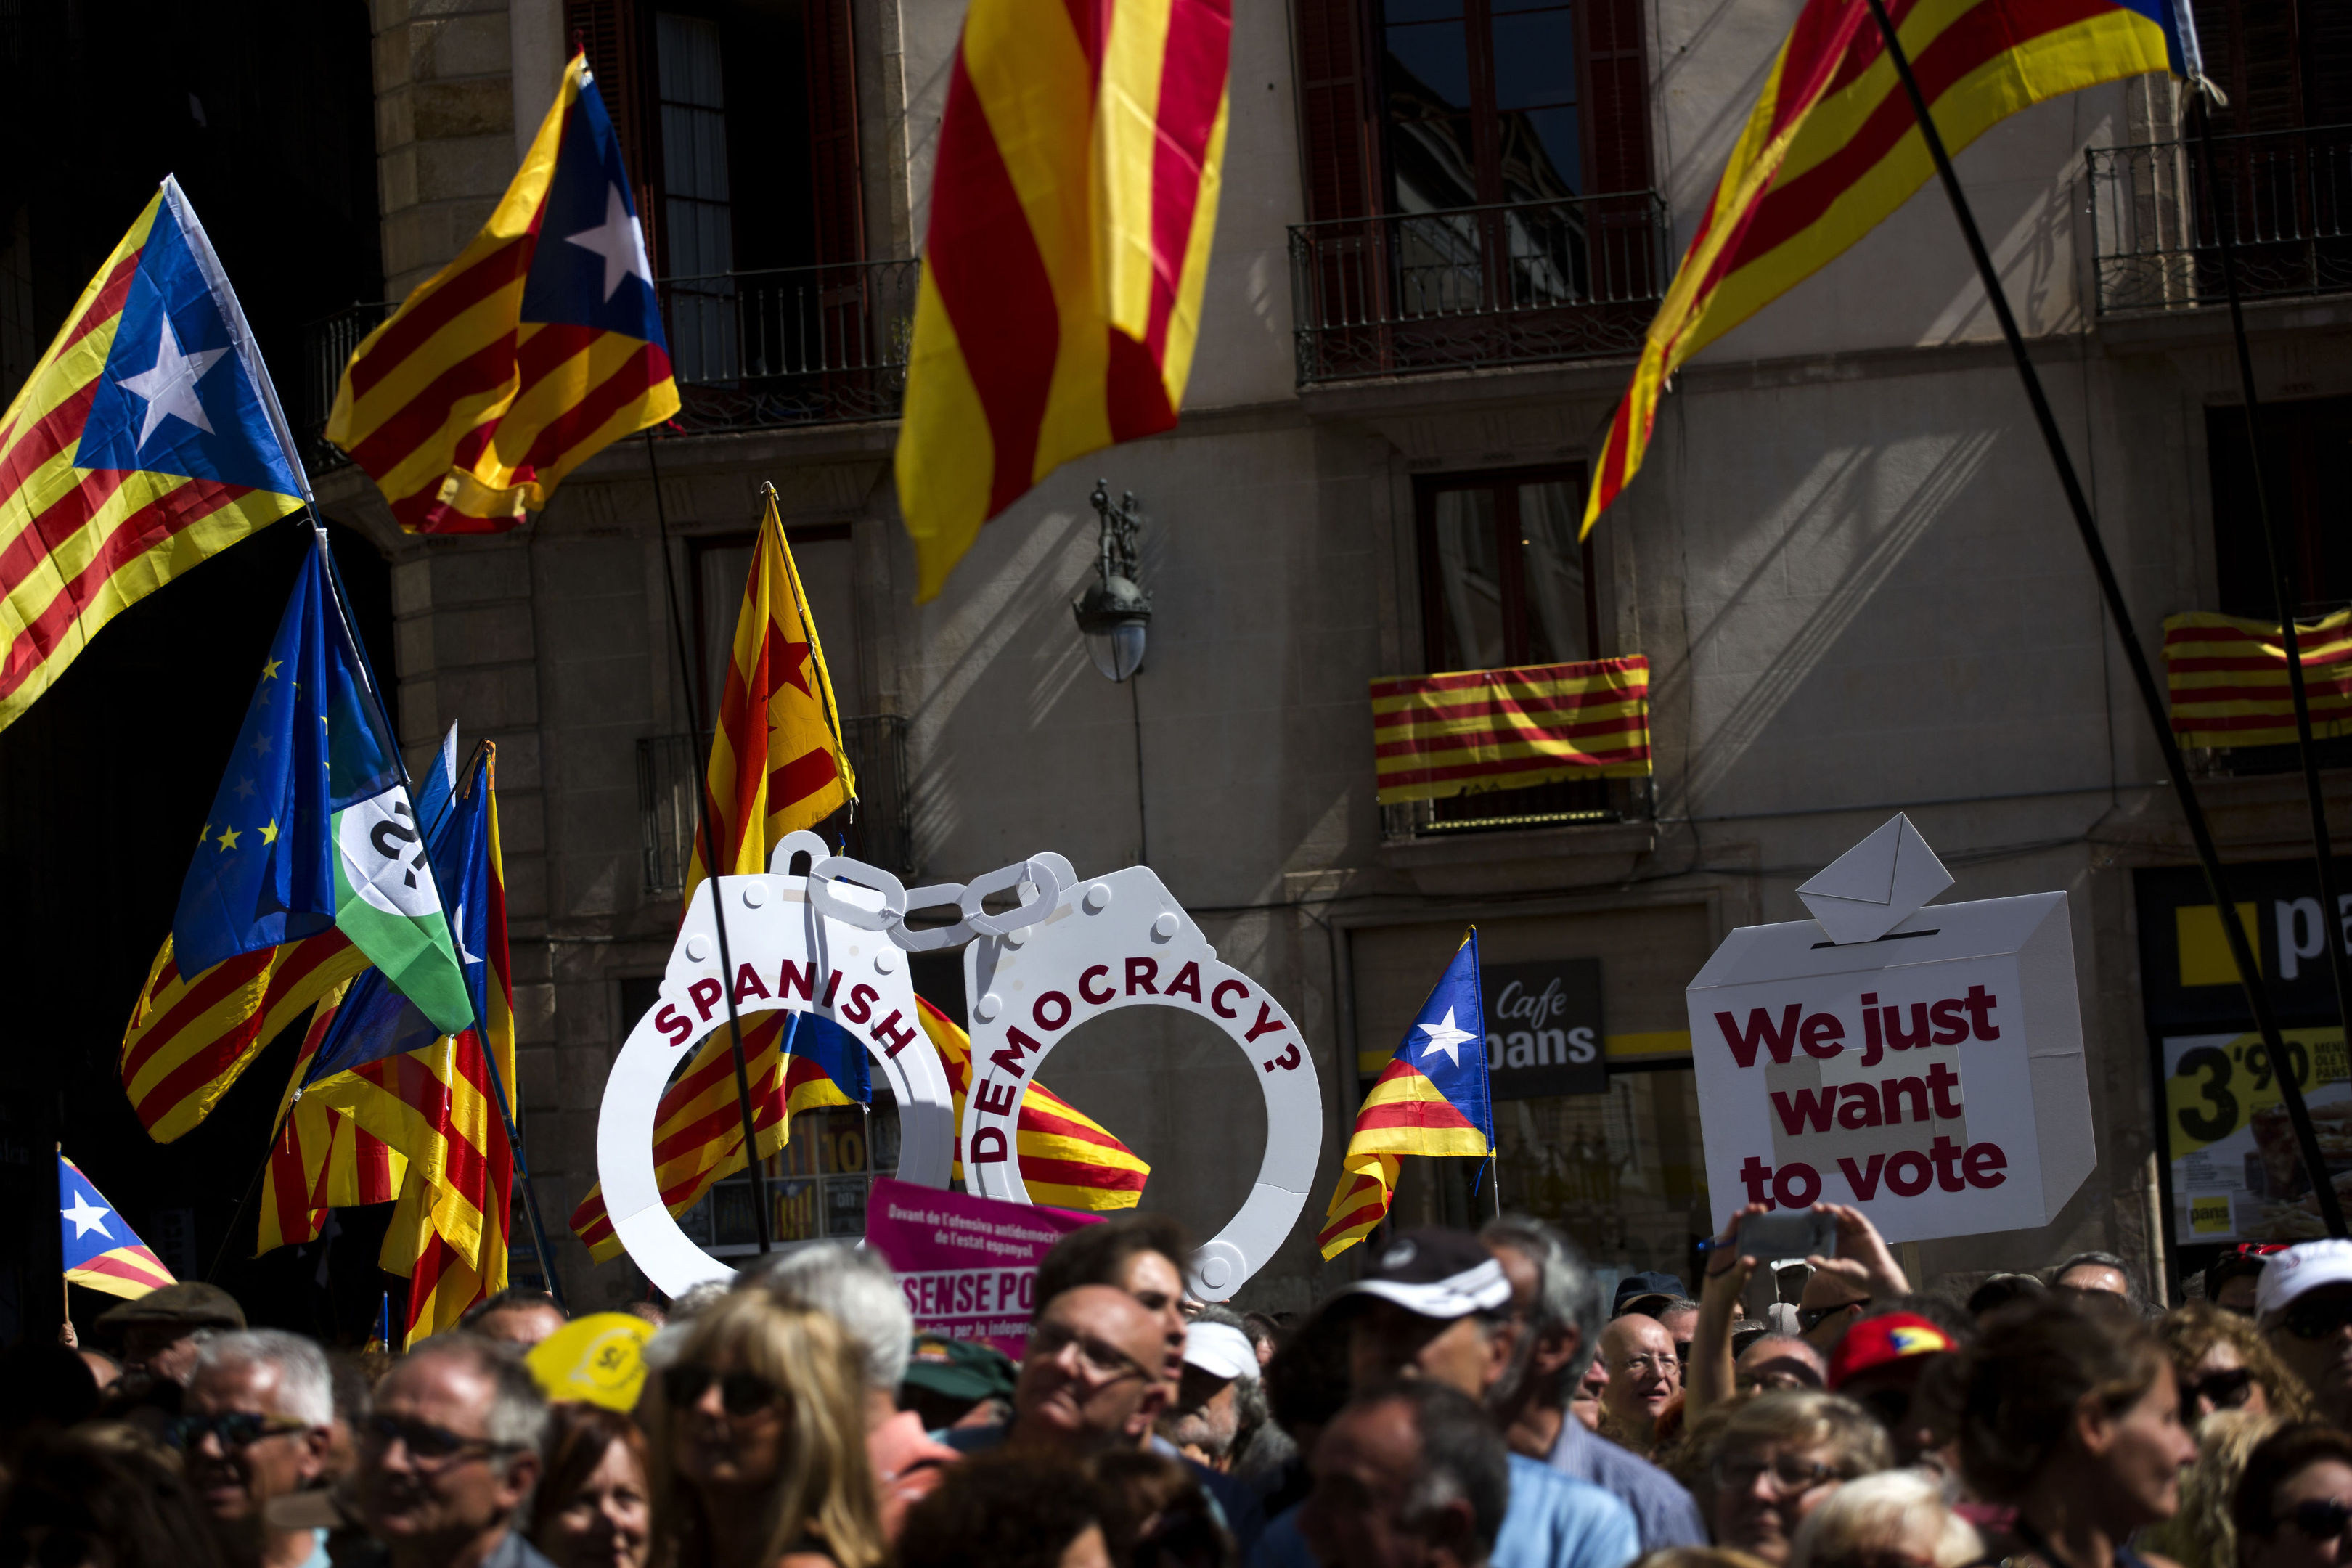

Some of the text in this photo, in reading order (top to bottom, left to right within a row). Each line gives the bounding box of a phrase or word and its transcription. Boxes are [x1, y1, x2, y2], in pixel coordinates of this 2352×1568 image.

[2274, 893, 2352, 979] p
[655, 959, 917, 1059] SPANISH
[1714, 984, 2000, 1068] We just
[970, 957, 1302, 1164] DEMOCRACY?
[1770, 1062, 1961, 1136] want
[1740, 1135, 2008, 1212] to vote
[888, 1203, 925, 1222] Davant
[927, 1210, 942, 1225] de
[942, 1212, 993, 1234] l'ofensiva
[934, 1230, 1033, 1259] de l'estat espanyol
[903, 1273, 992, 1315] SENSE
[954, 1324, 973, 1341] per
[975, 1321, 986, 1336] la
